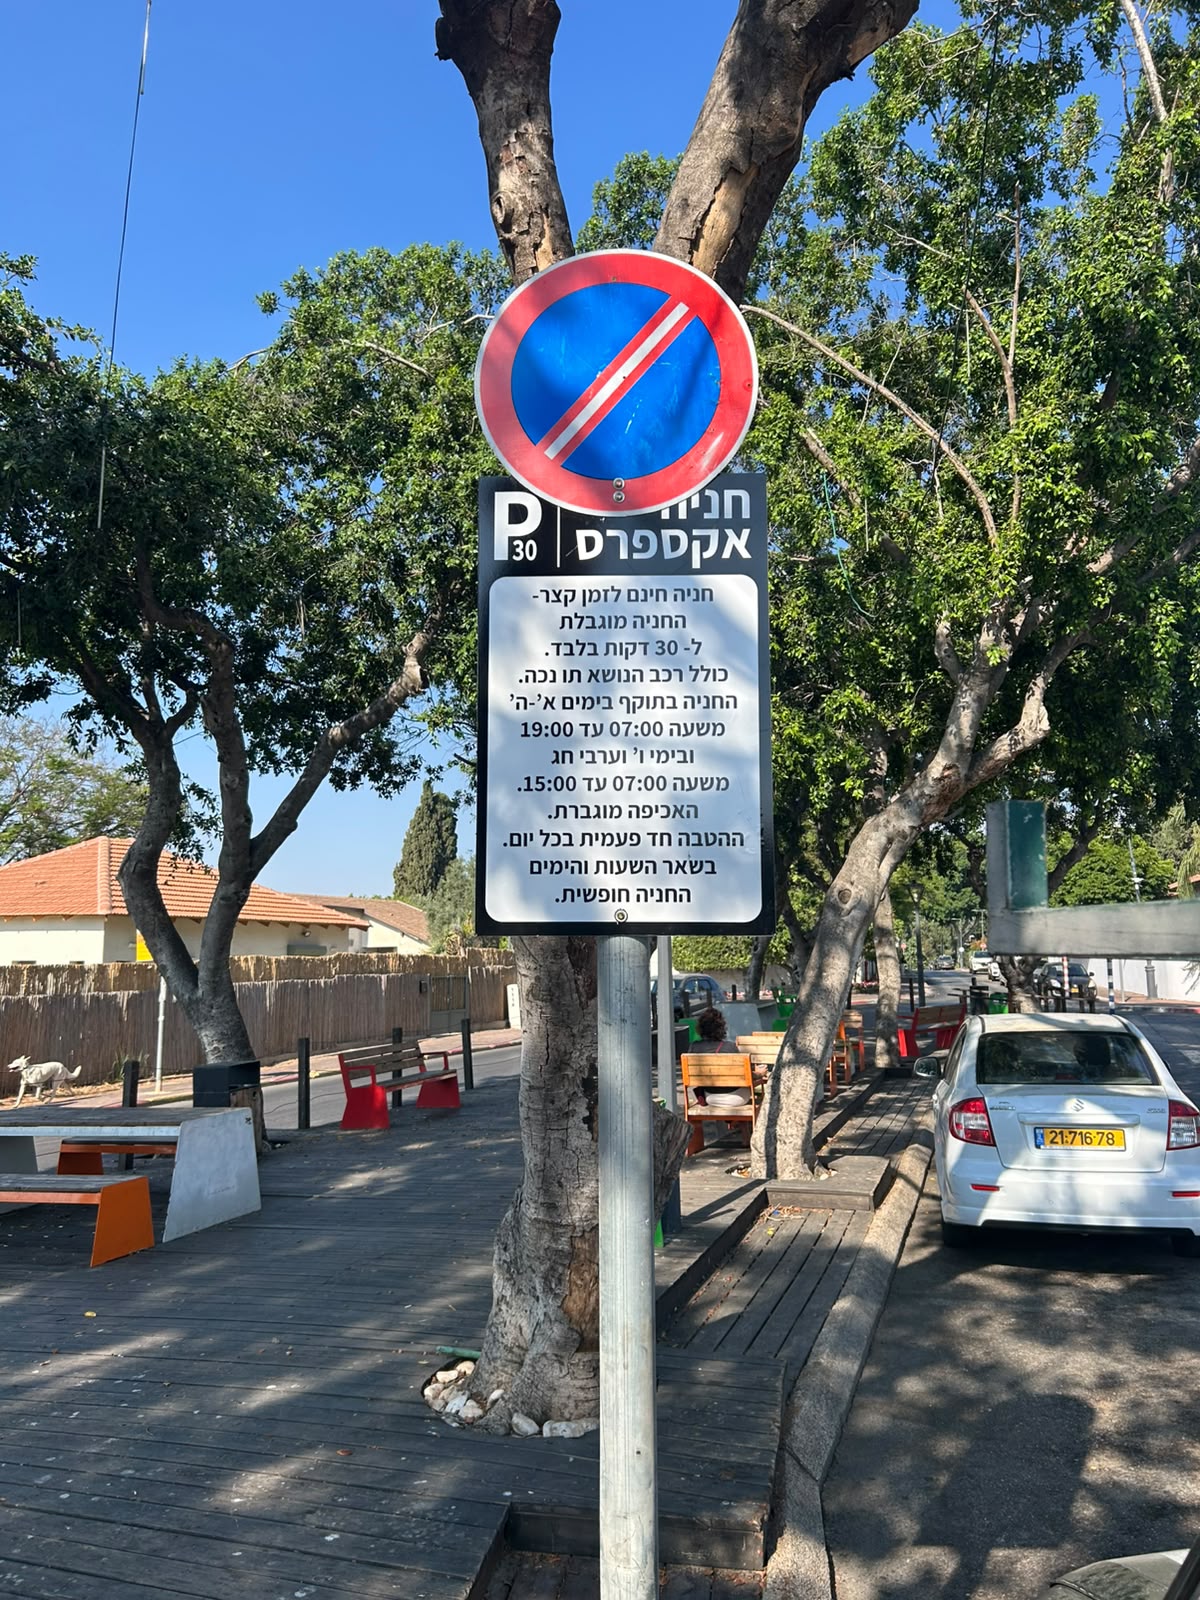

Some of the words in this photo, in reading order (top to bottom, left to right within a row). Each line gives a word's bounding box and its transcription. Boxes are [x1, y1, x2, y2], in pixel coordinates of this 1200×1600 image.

[494, 491, 542, 560] P
[512, 539, 537, 561] 30
[575, 528, 752, 568] אקספרס
[532, 585, 576, 607] קצר-
[582, 585, 621, 607] לזמן
[627, 587, 667, 603] חינם
[674, 587, 714, 603] חניה
[559, 612, 627, 630] מוגבלת
[633, 614, 687, 630] החניה
[545, 638, 599, 657] בלבד.
[604, 641, 649, 660] דקות
[655, 639, 678, 656] 30
[519, 668, 557, 684] נכה.
[563, 668, 582, 684] תו
[587, 668, 644, 684] הנושא
[649, 668, 683, 683] רכב
[689, 665, 729, 683] כולל
[562, 695, 613, 711] בימים
[619, 695, 678, 714] בתוקף
[684, 694, 738, 710] החניה
[521, 721, 574, 738] 19:00
[579, 722, 604, 738] עד
[609, 721, 663, 737] 07:00
[669, 721, 726, 738] משעה
[551, 749, 574, 765] חג
[580, 749, 627, 764] וערבי
[650, 749, 694, 764] ובימי
[517, 775, 577, 792] 15:00.
[582, 776, 607, 792] עד
[613, 775, 667, 792] 07:00
[673, 776, 730, 792] משעה
[548, 804, 623, 820] מוגברת.
[628, 804, 699, 820] האכיפה
[503, 832, 534, 848] יום.
[539, 829, 574, 848] בכל
[579, 831, 641, 848] פעמית
[646, 831, 673, 847] חד
[678, 831, 745, 847] ההטבה
[529, 859, 589, 876] והימים
[594, 859, 657, 876] השעות
[661, 859, 717, 875] בשאר
[555, 887, 630, 904] חופשית.
[636, 887, 692, 903] החניה
